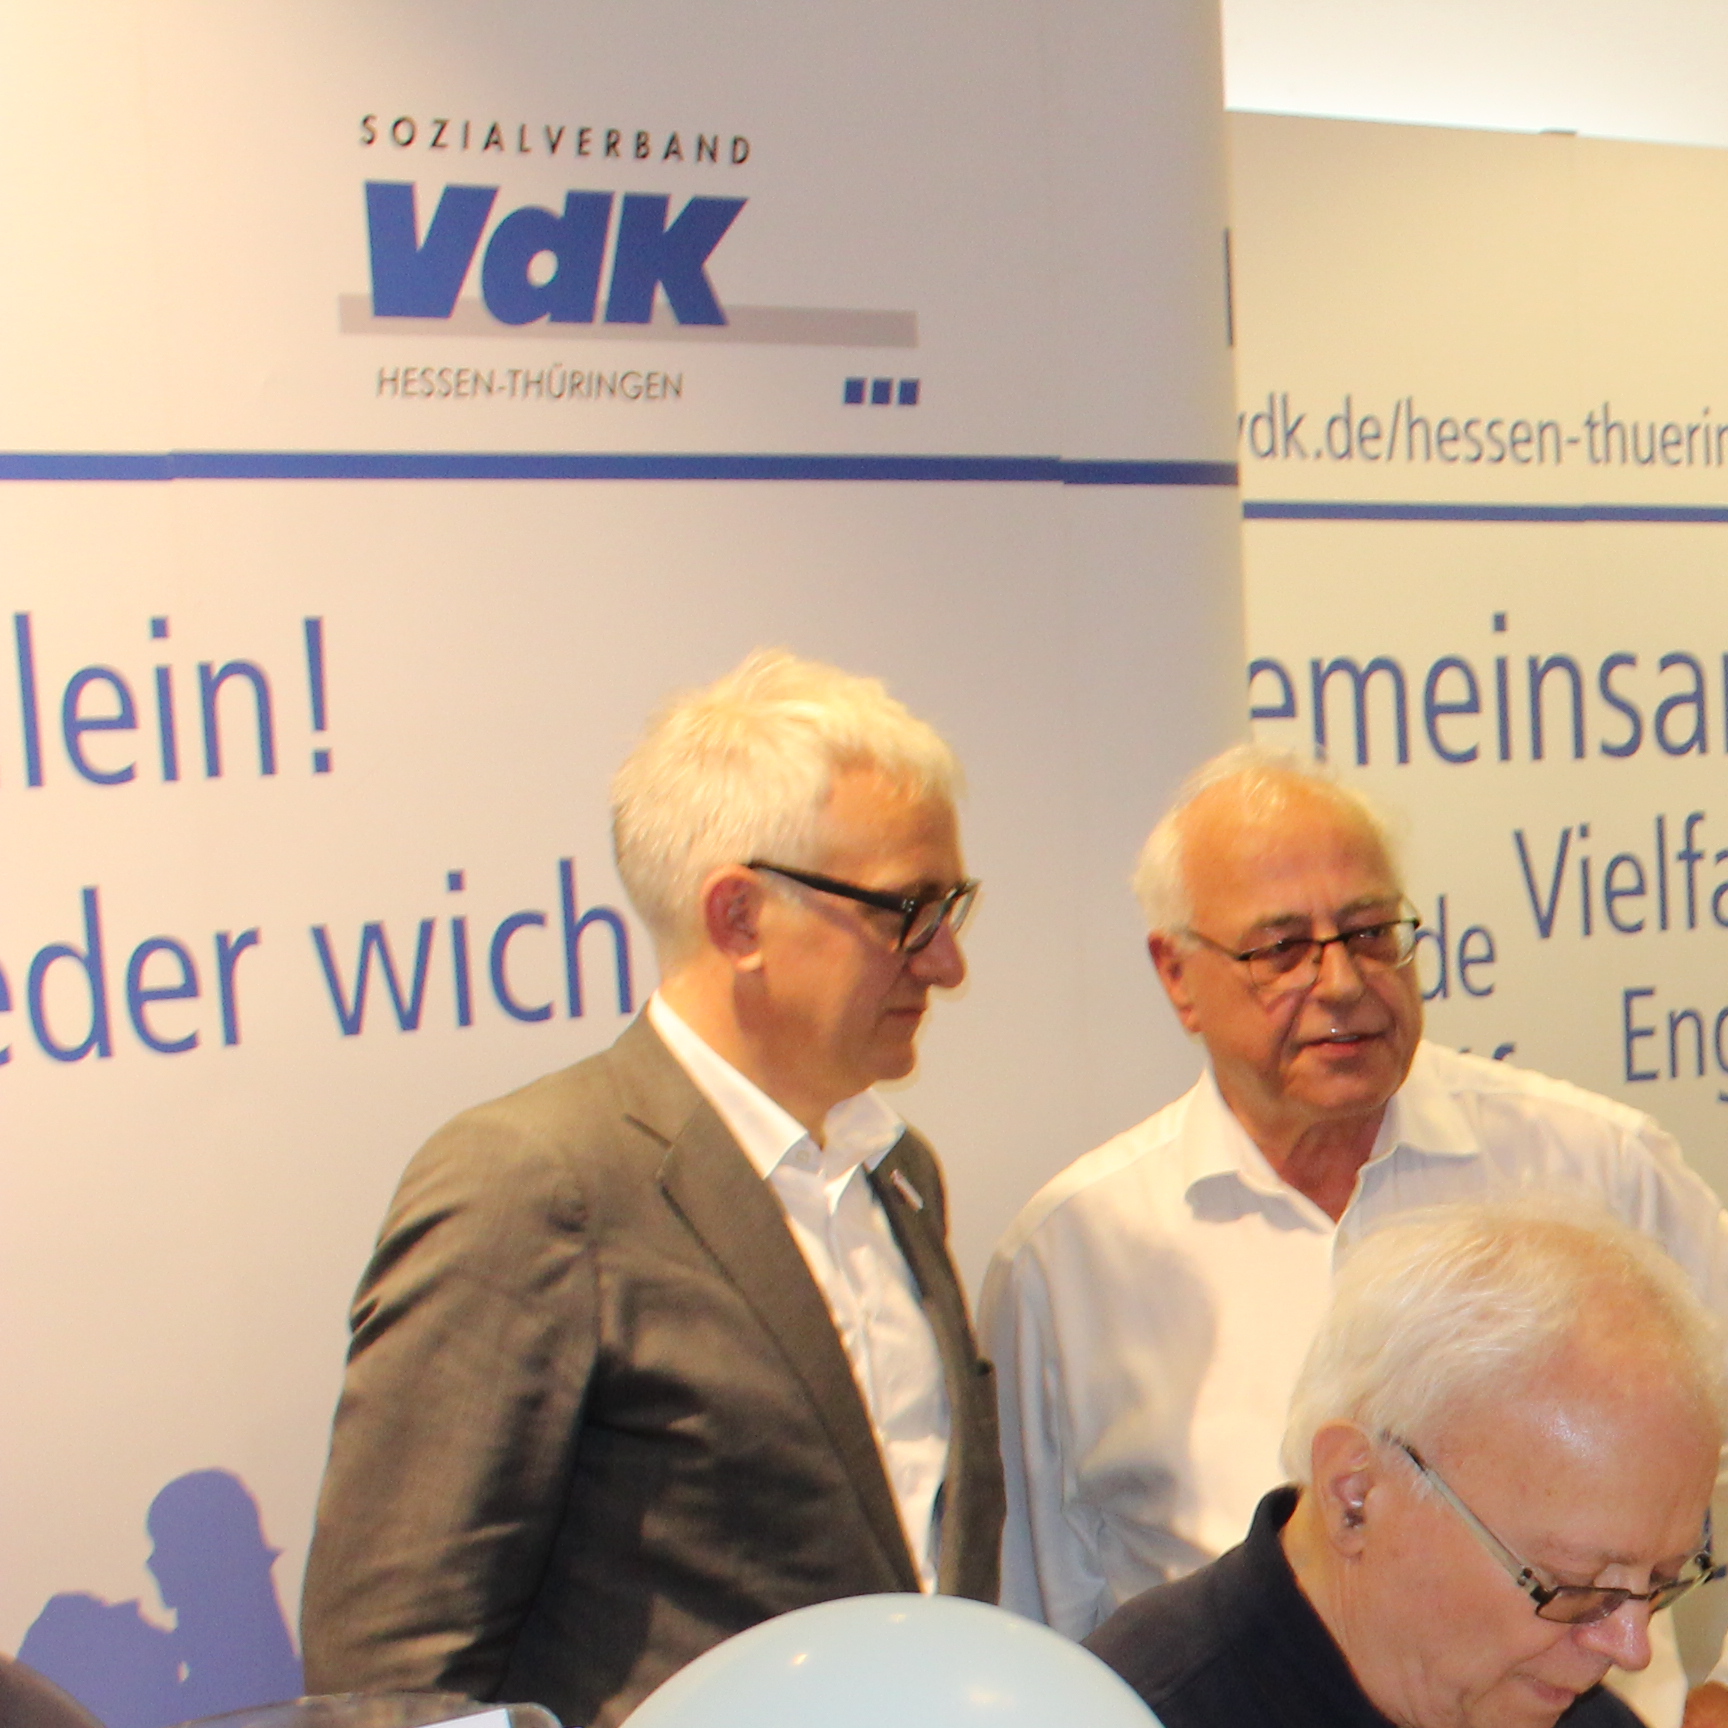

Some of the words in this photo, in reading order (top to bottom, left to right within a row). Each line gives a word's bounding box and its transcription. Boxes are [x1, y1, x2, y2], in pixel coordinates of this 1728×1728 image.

[361, 113, 752, 165] SOZIALVERBAND
[364, 179, 750, 326] VdK
[376, 363, 684, 401] HESSEN-THÜRINGEN
[0, 885, 261, 1067] der
[310, 856, 634, 1037] wich
